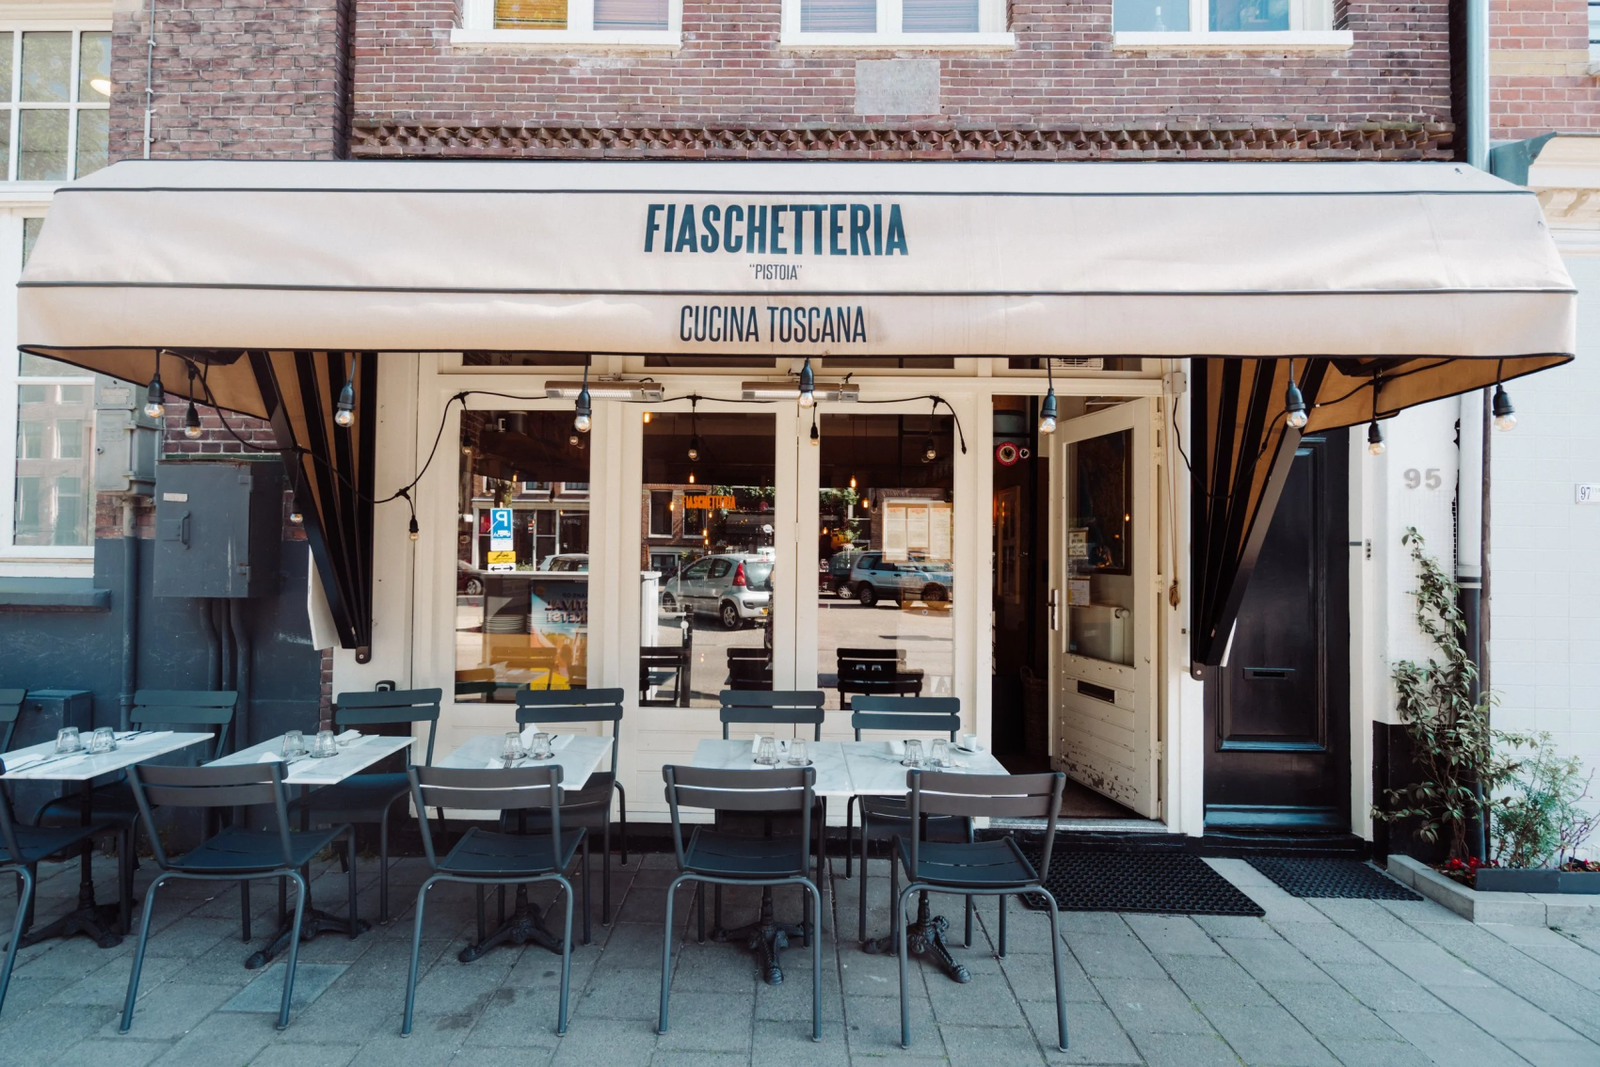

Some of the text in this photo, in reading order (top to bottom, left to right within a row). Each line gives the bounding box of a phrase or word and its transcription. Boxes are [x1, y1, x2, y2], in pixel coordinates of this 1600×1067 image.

[644, 203, 909, 256] FIASCHETTERIA
[679, 305, 867, 343] CUCINA TOSCANA
[1403, 468, 1442, 490] 95
[1580, 486, 1591, 500] 97
